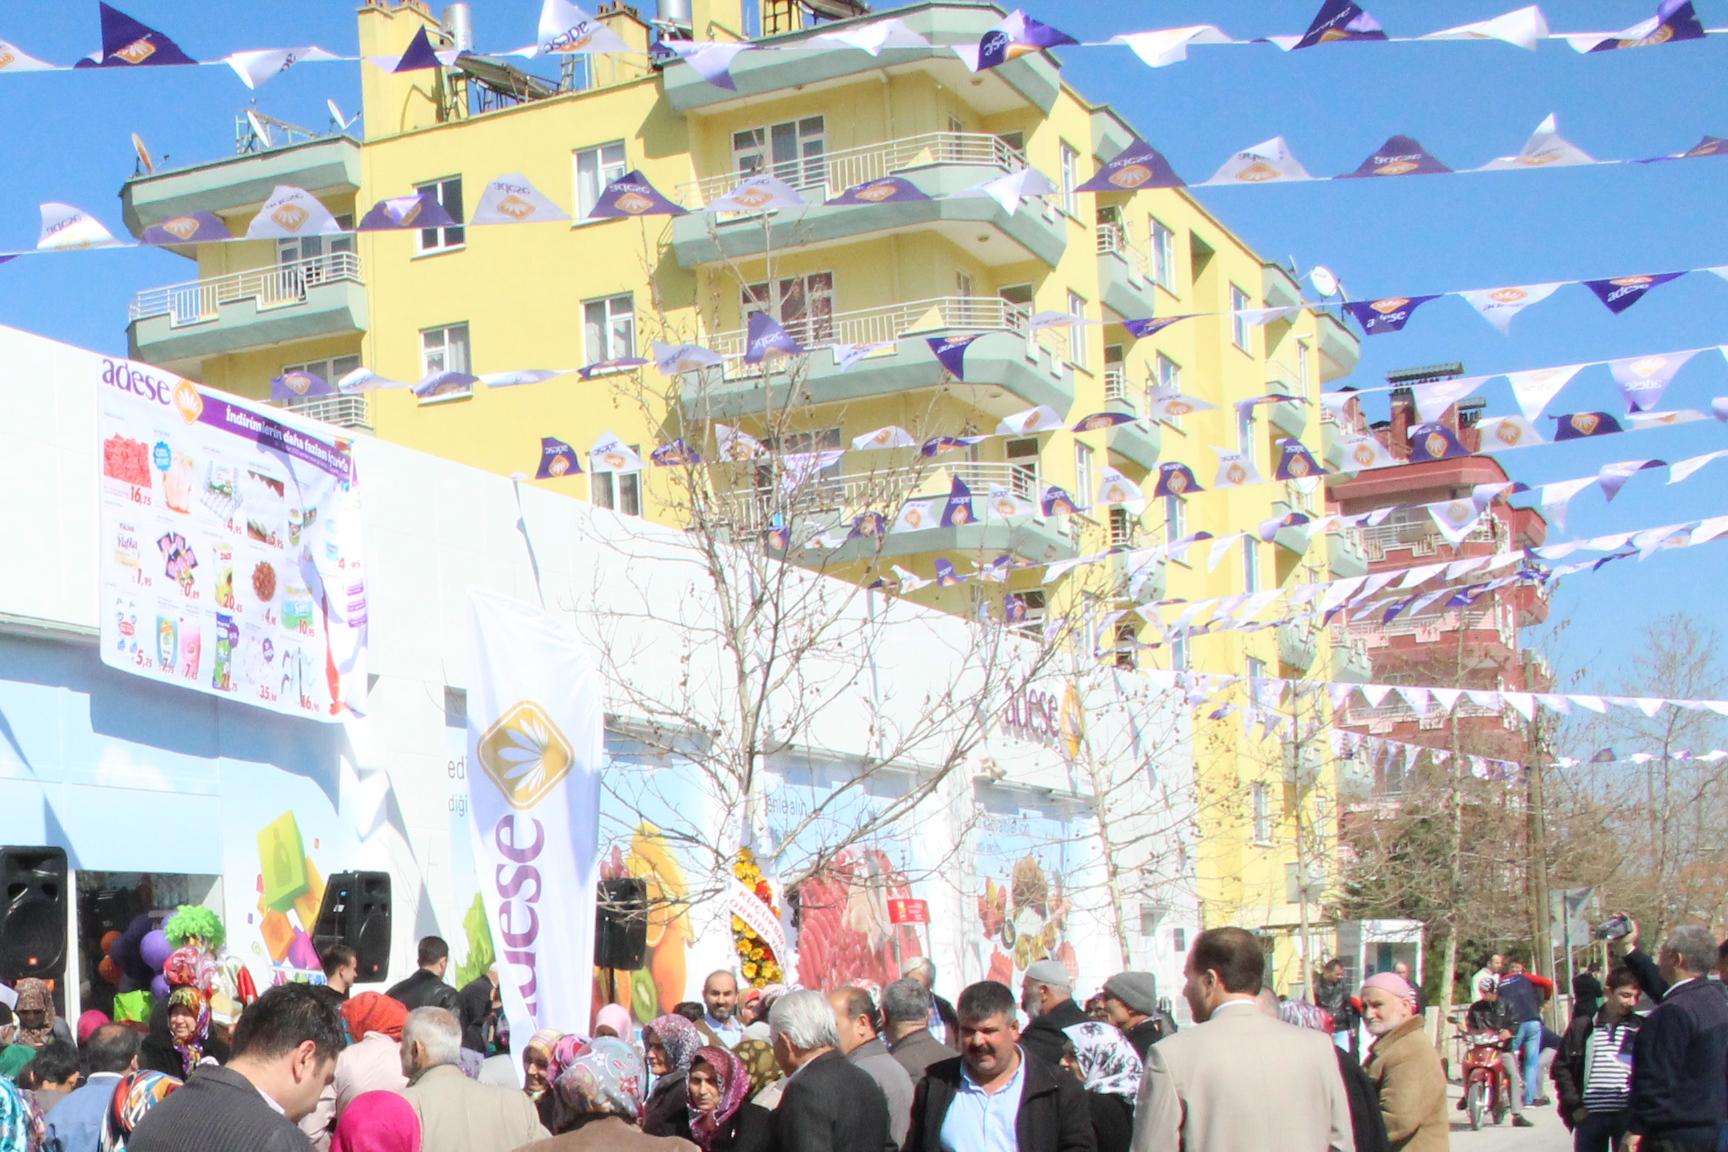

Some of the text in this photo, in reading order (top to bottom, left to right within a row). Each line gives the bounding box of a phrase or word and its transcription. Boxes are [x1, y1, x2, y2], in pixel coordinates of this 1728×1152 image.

[102, 358, 171, 406] adese
[283, 430, 304, 451] daha
[130, 486, 152, 506] 16,75
[117, 535, 138, 551] Yufka
[136, 651, 153, 669] 5,75
[729, 898, 771, 939] ORKİDE
